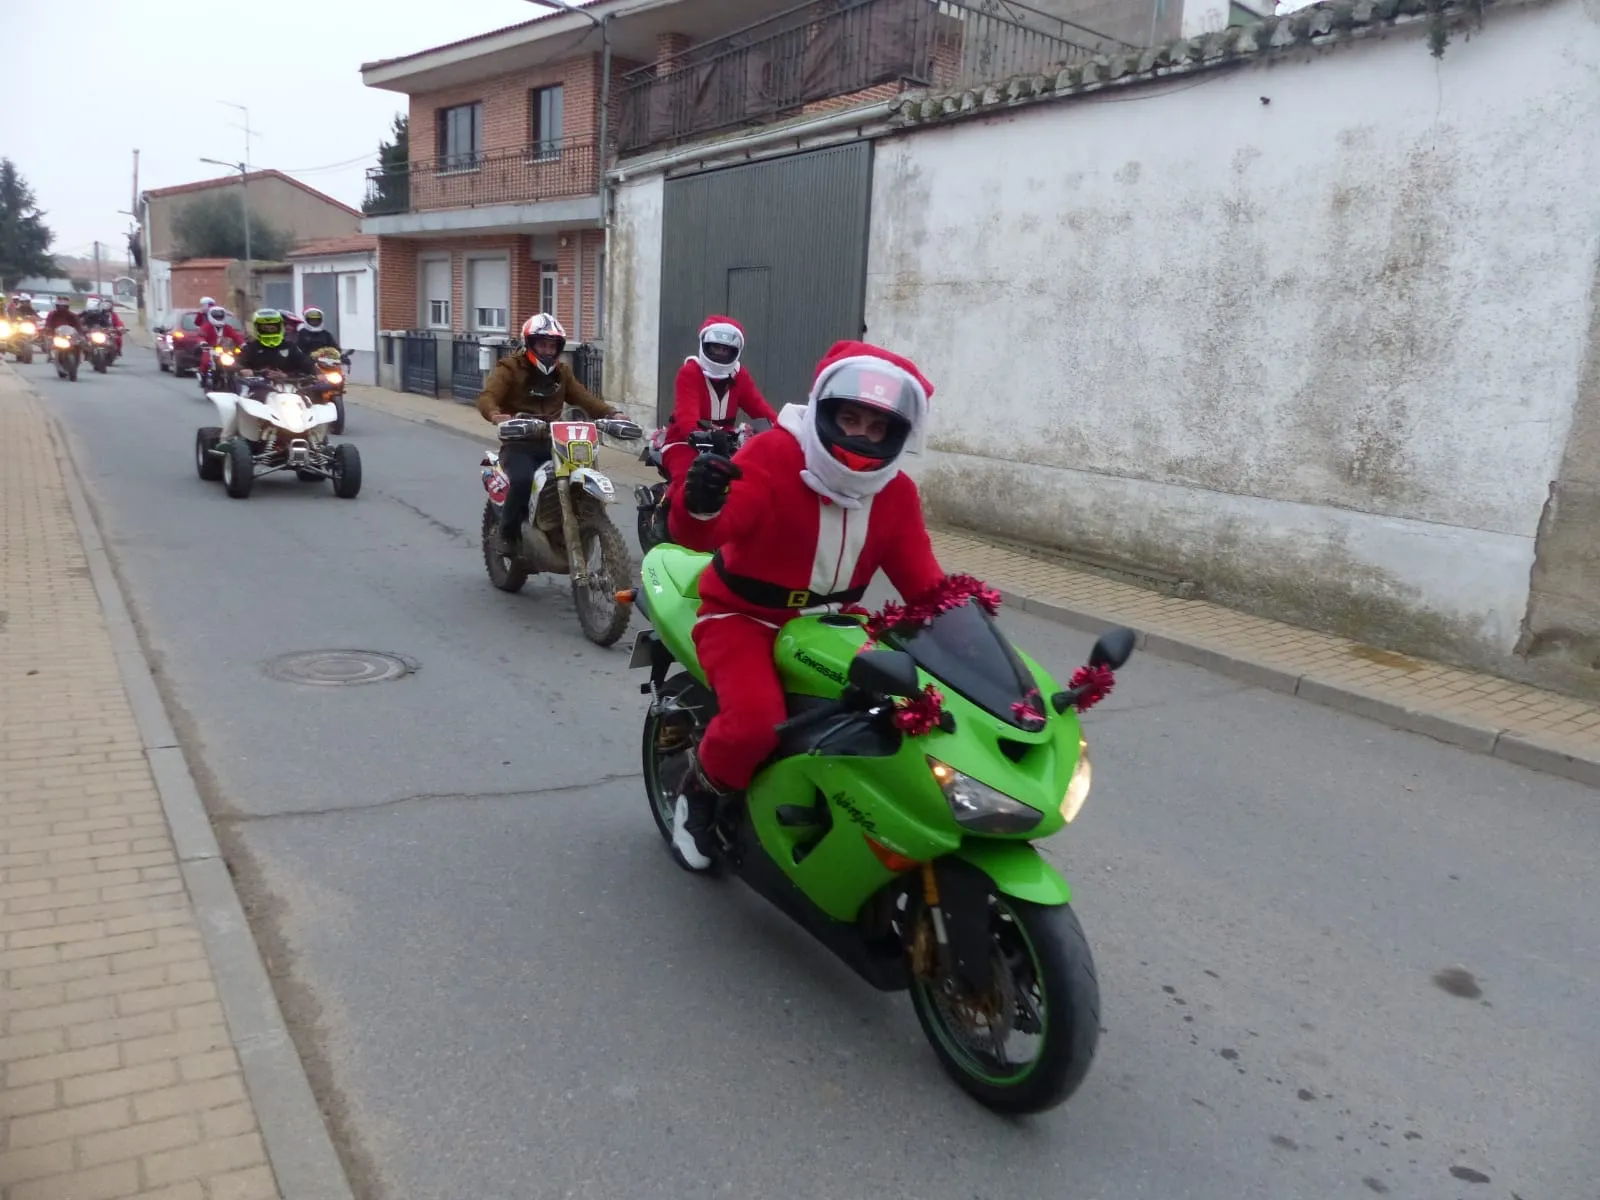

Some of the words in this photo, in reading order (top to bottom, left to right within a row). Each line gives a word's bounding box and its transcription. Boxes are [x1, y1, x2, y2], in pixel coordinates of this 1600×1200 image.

[567, 426, 589, 440] 17
[794, 648, 848, 686] Kawasaki
[832, 791, 878, 834] Ninja
